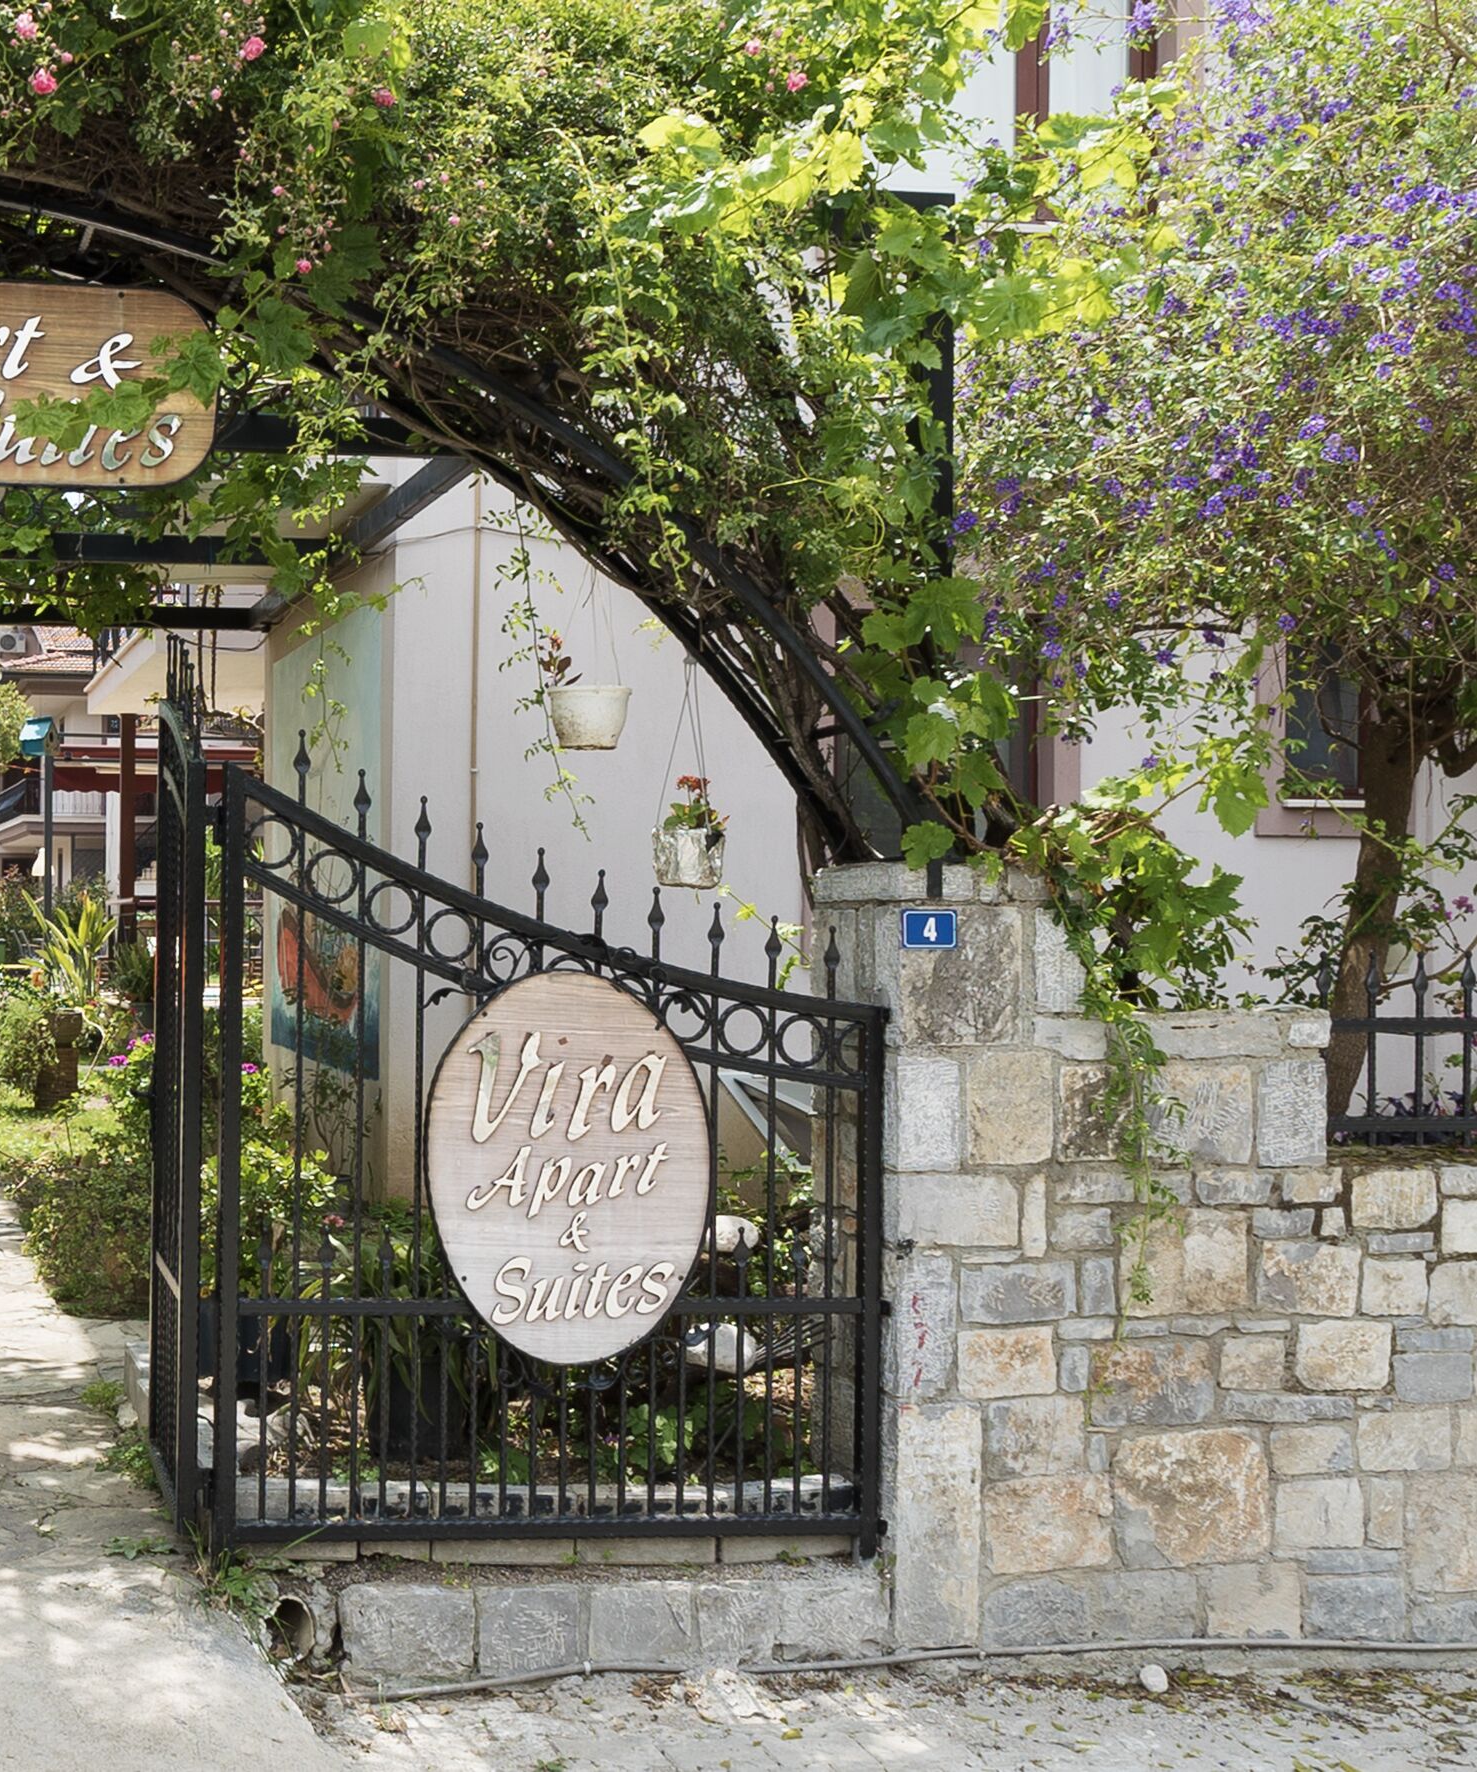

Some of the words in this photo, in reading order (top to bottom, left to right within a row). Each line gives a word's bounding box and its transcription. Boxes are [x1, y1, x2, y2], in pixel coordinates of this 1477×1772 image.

[71, 333, 146, 389] &
[922, 916, 938, 942] 4
[467, 1031, 668, 1144] Vira
[465, 1141, 669, 1219] Apart
[558, 1211, 590, 1253] &
[491, 1255, 675, 1325] Suites
